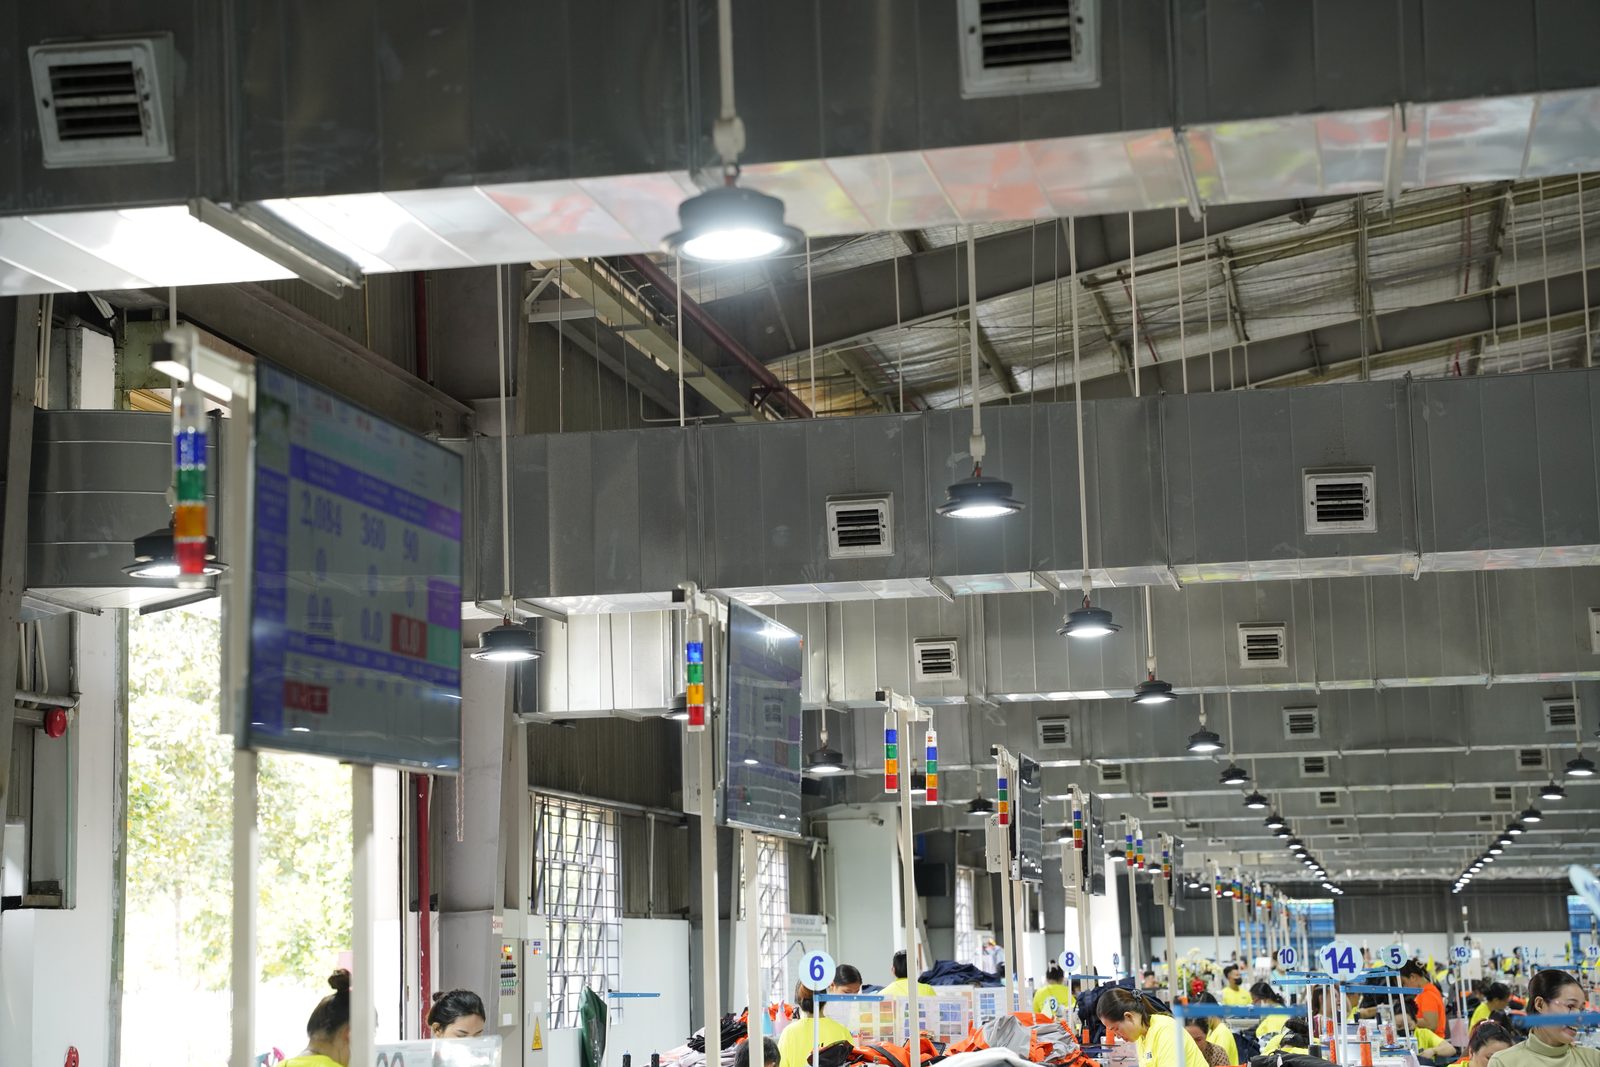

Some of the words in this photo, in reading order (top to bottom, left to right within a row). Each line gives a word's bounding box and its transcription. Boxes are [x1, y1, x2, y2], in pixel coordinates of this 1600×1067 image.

[1280, 949, 1294, 964] 10
[1391, 948, 1401, 964] 5
[1455, 947, 1466, 957] 16
[1589, 946, 1598, 955] 11
[1066, 952, 1075, 967] 8
[1325, 947, 1356, 974] 14
[809, 956, 824, 981] 6
[1050, 999, 1056, 1009] 3
